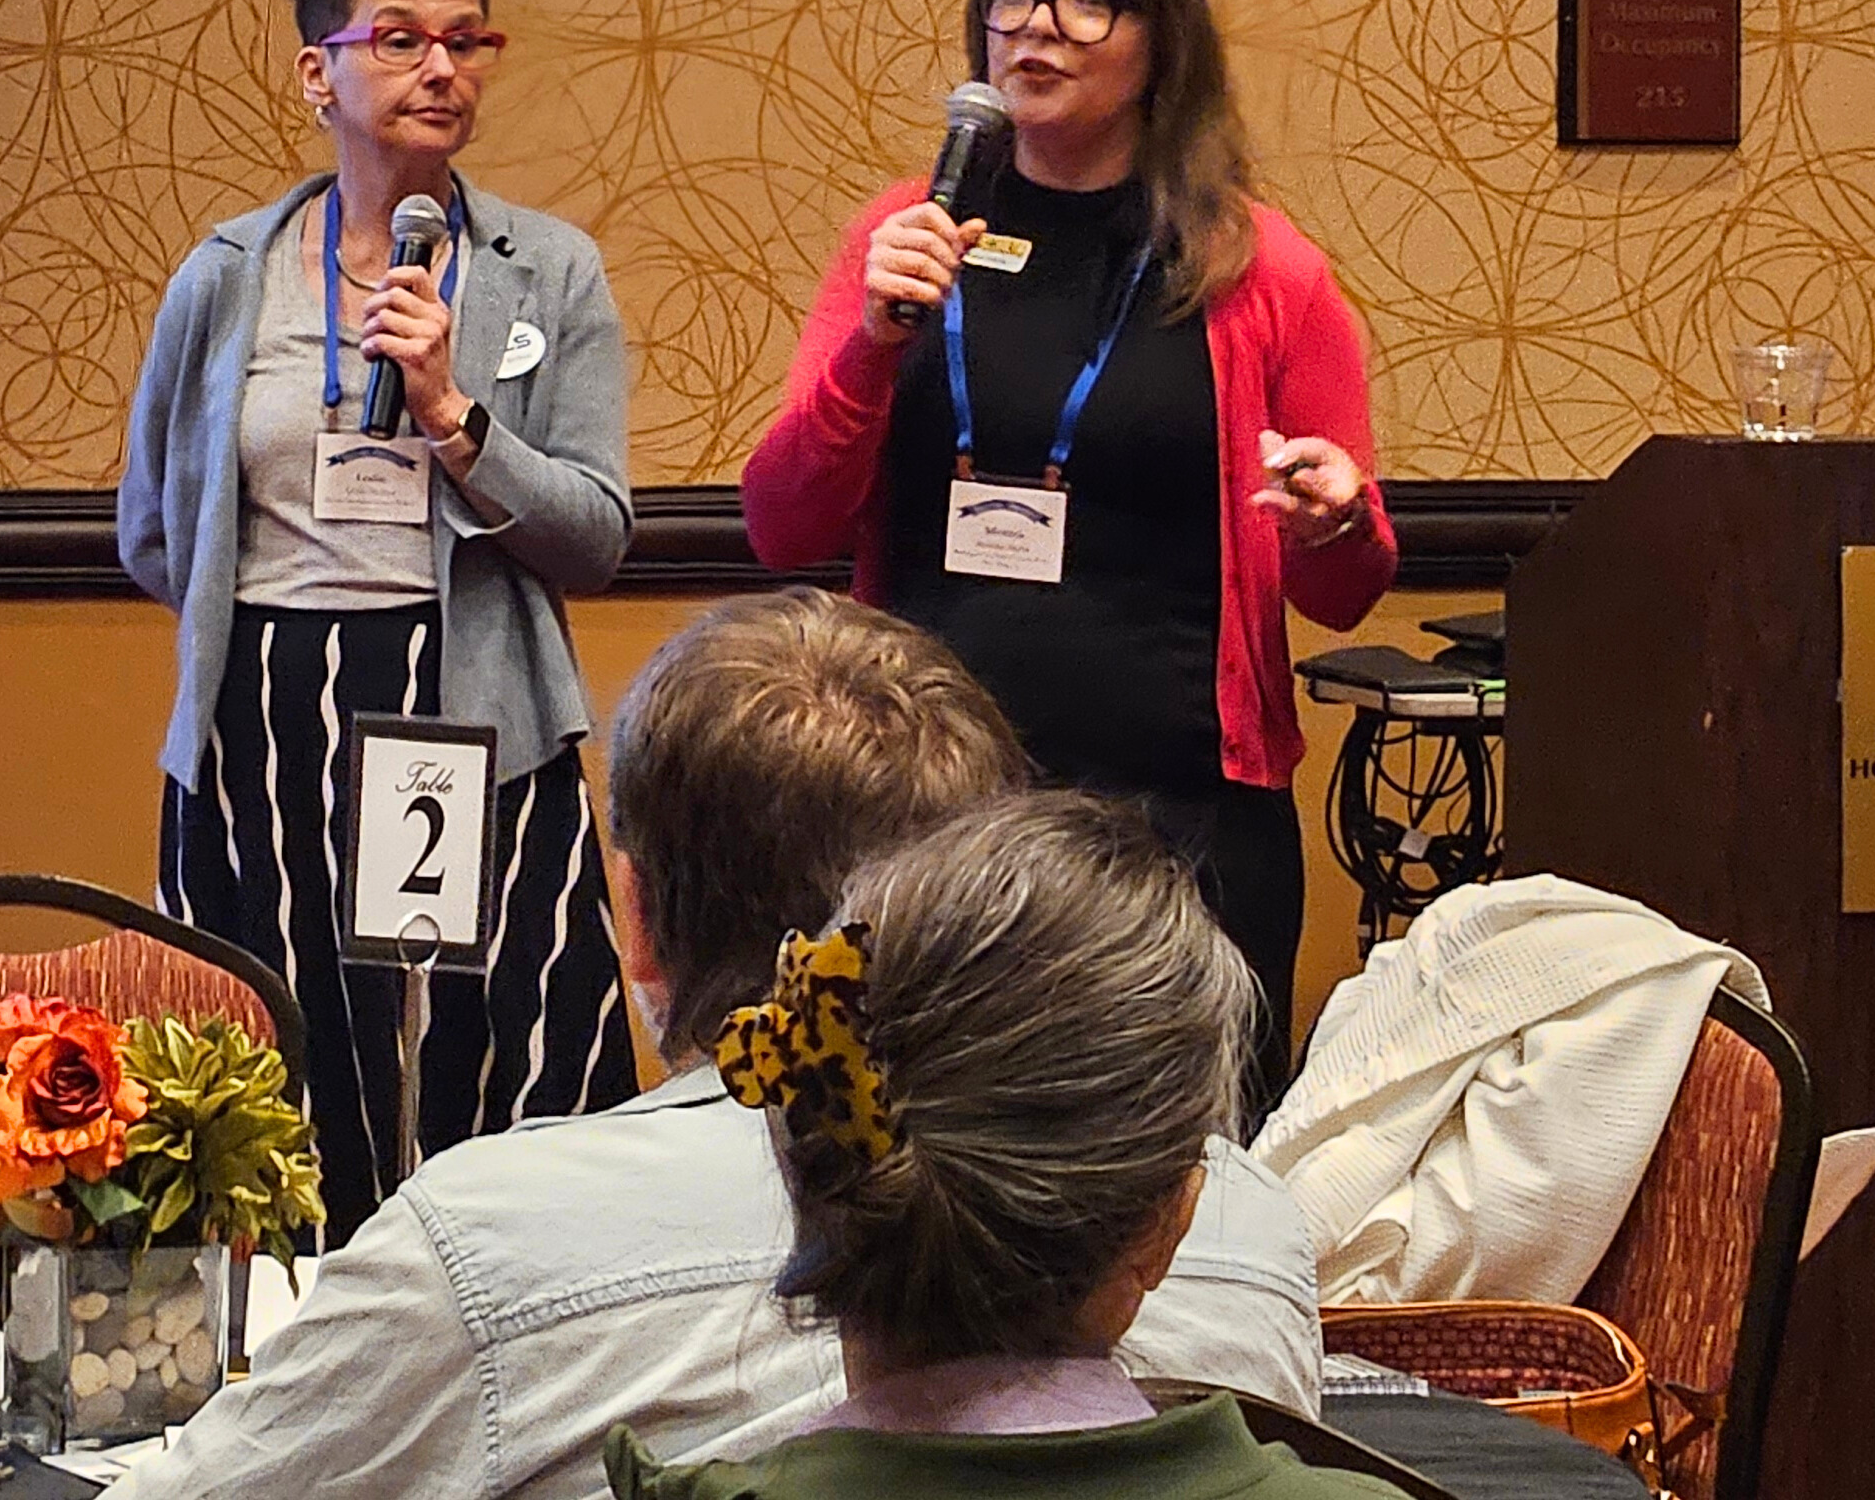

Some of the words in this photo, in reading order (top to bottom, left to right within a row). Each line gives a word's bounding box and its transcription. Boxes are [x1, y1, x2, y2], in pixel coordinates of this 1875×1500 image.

[394, 761, 455, 795] Table
[1850, 759, 1875, 779] H
[398, 795, 446, 896] 2
